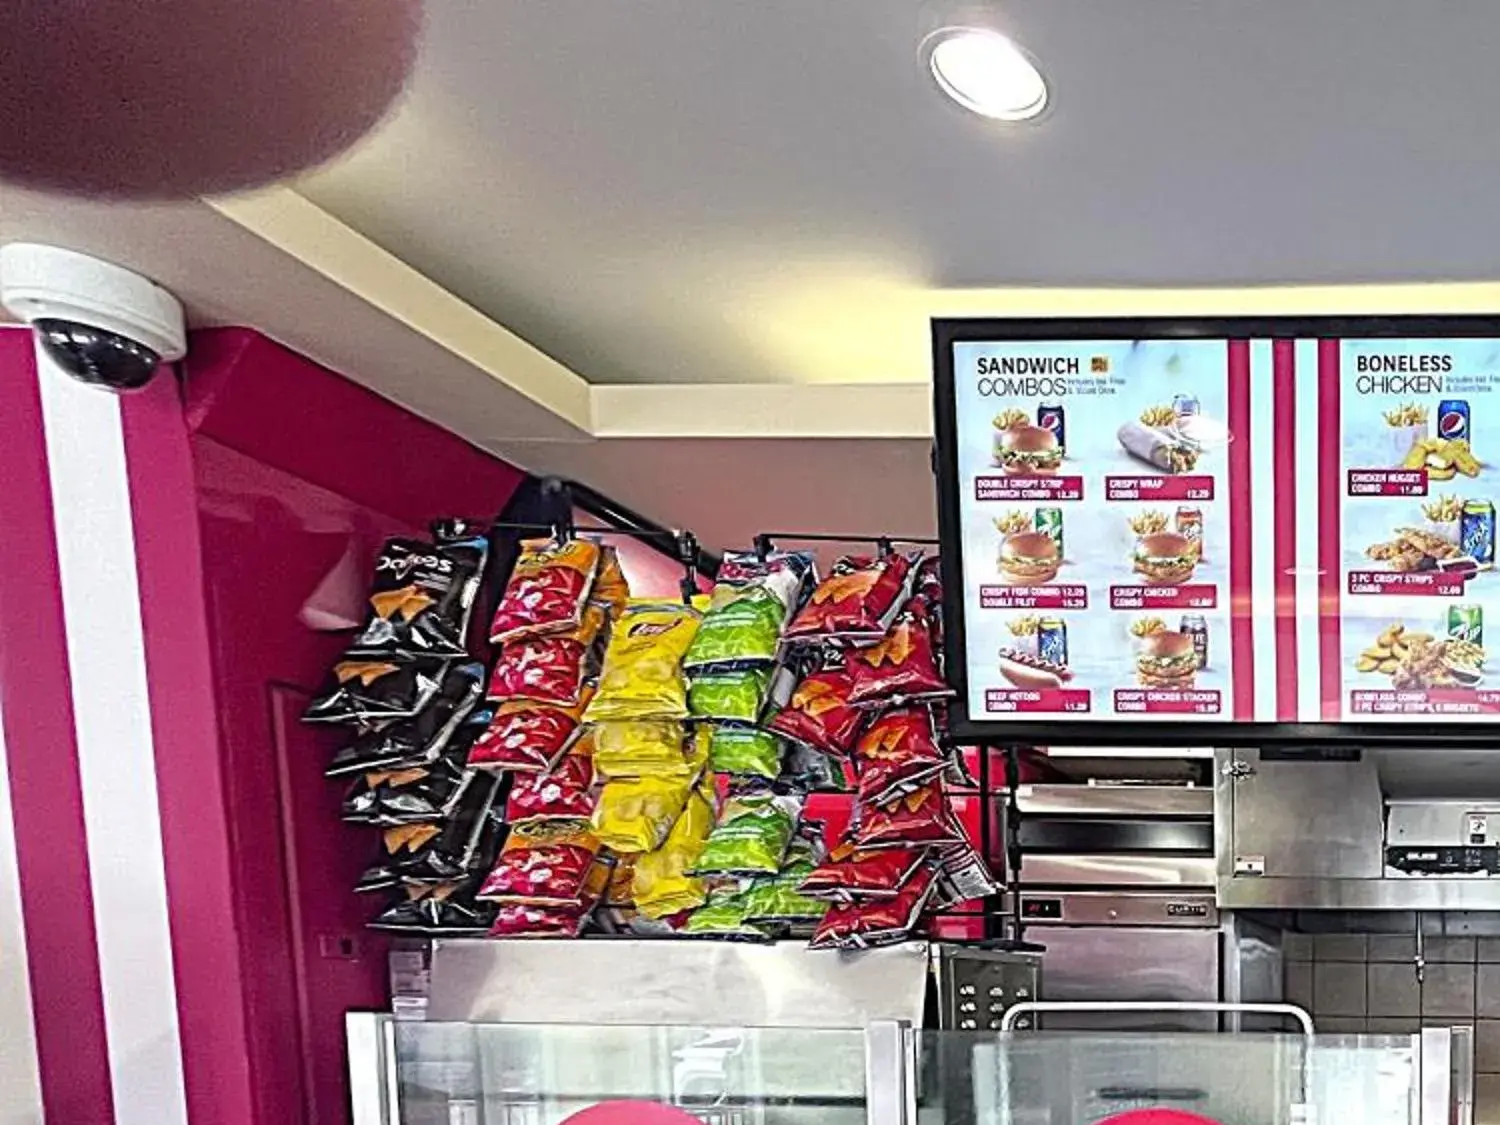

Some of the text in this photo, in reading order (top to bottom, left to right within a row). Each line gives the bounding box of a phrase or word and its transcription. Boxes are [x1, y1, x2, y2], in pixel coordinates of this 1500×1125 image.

[977, 357, 1079, 375] SANDWICH
[1357, 355, 1453, 372] BONELESS
[977, 377, 1067, 397] COMBOS
[1356, 375, 1443, 395] CHICKEN
